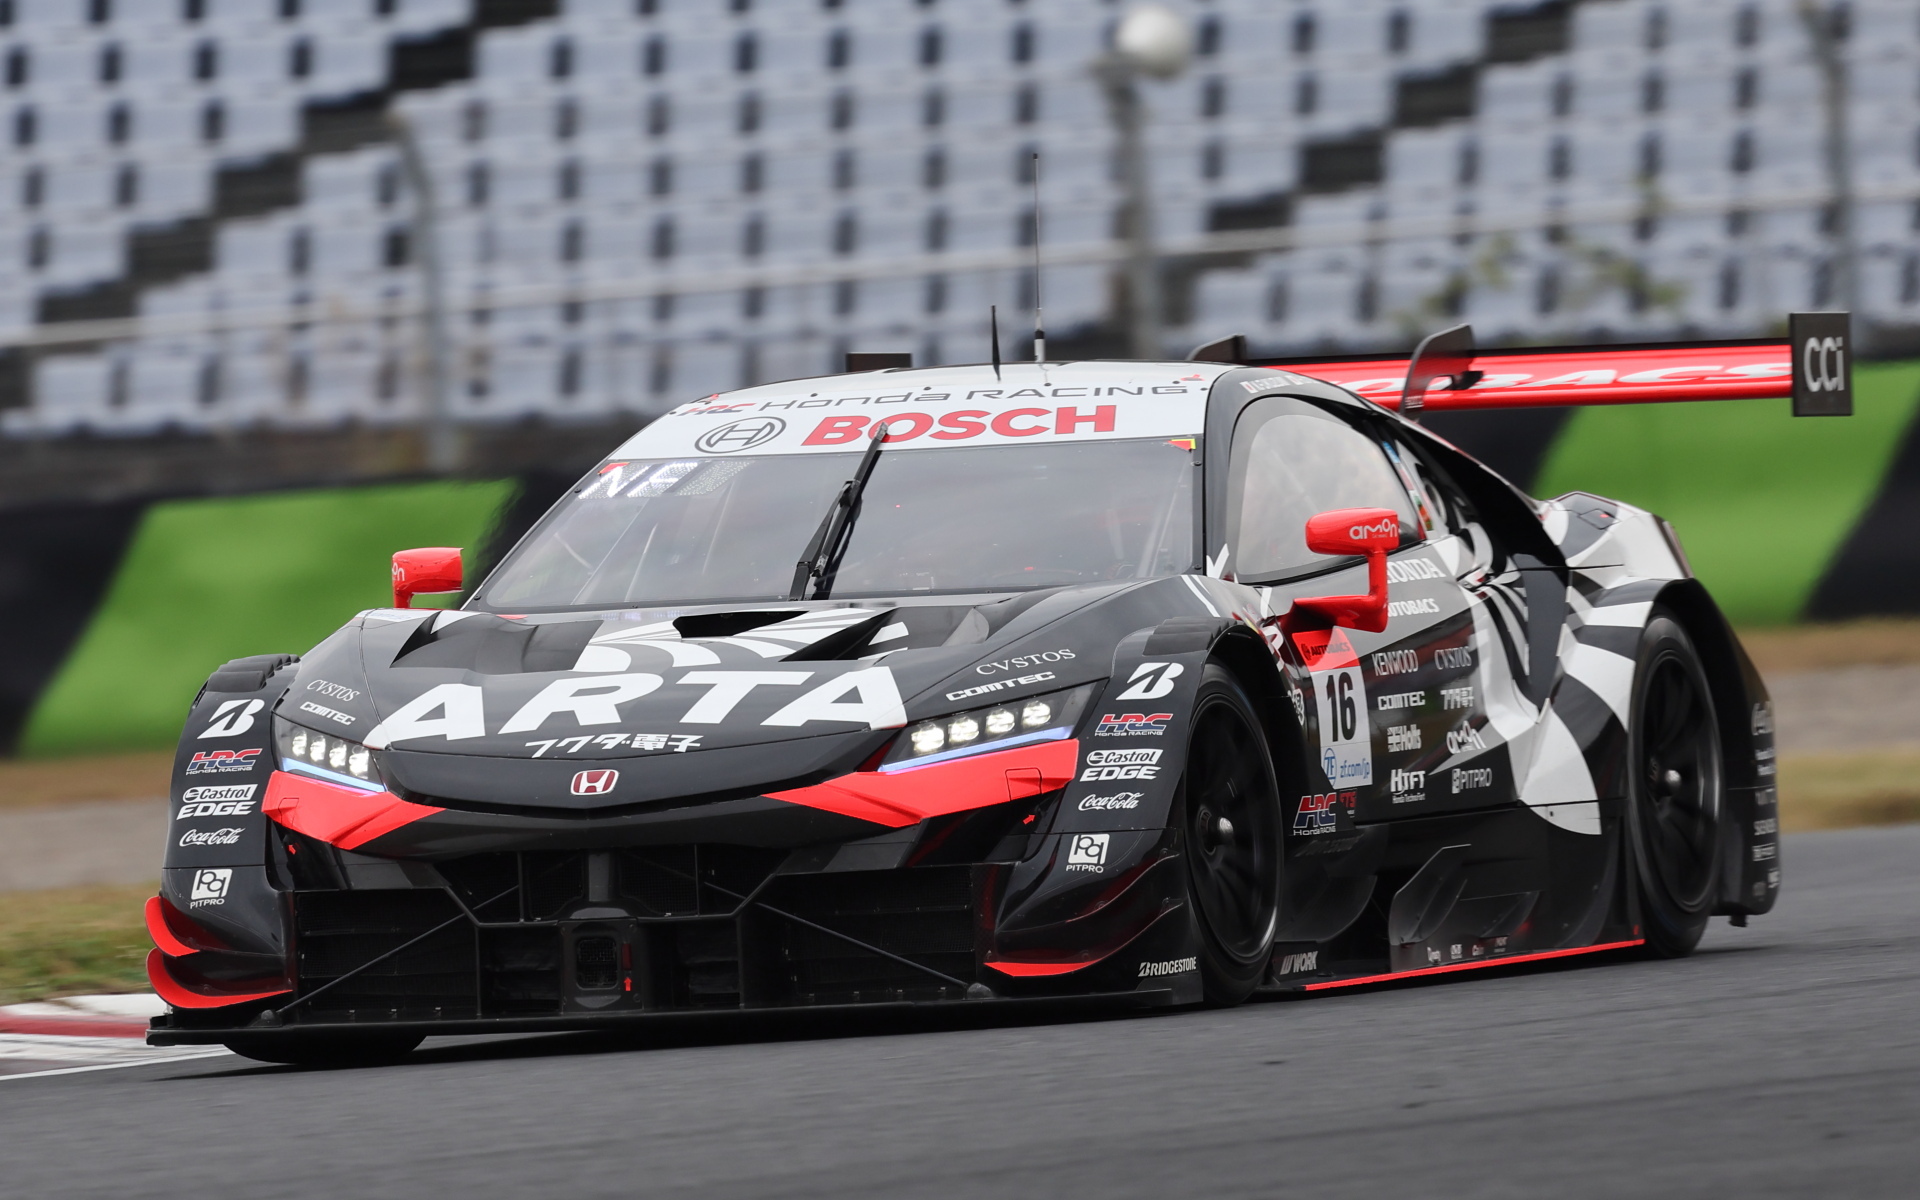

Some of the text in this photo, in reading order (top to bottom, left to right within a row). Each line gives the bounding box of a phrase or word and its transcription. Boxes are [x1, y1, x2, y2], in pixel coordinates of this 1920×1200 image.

[758, 391, 951, 412] Honda
[966, 384, 1189, 401] RACING
[801, 405, 1117, 446] BOSCH
[1387, 597, 1440, 617] UTOBACS
[1311, 642, 1350, 656] AUTOBACS
[976, 648, 1076, 675] CVSTOS
[1371, 648, 1419, 676] KENWOOD
[306, 679, 361, 702] CVSTOS
[945, 671, 1056, 701] COMTEC
[363, 666, 907, 749] ARTA
[1326, 672, 1357, 742] 16
[1377, 691, 1426, 710] COMTEC
[300, 702, 356, 726] COMTEC
[1095, 713, 1173, 732] HRC
[525, 733, 704, 758] フクダ電子
[186, 748, 263, 771] HRC
[1103, 750, 1157, 766] Castrol
[1340, 758, 1371, 779] zf.com/jp
[186, 768, 217, 776] Honda
[1079, 766, 1162, 782] EDGE
[1460, 768, 1493, 790] PITPRO
[199, 786, 251, 801] Castrol
[1078, 792, 1144, 811] Coca-Cola
[176, 801, 257, 821] EDGE
[1293, 792, 1337, 828] HRC
[179, 827, 246, 847] Coca-Cola
[1320, 826, 1336, 834] RACING
[1066, 864, 1104, 874] PITPRO
[190, 897, 225, 909] PITPRO
[1138, 956, 1197, 977] BRIDGESTONE
[1293, 951, 1319, 973] WORK
